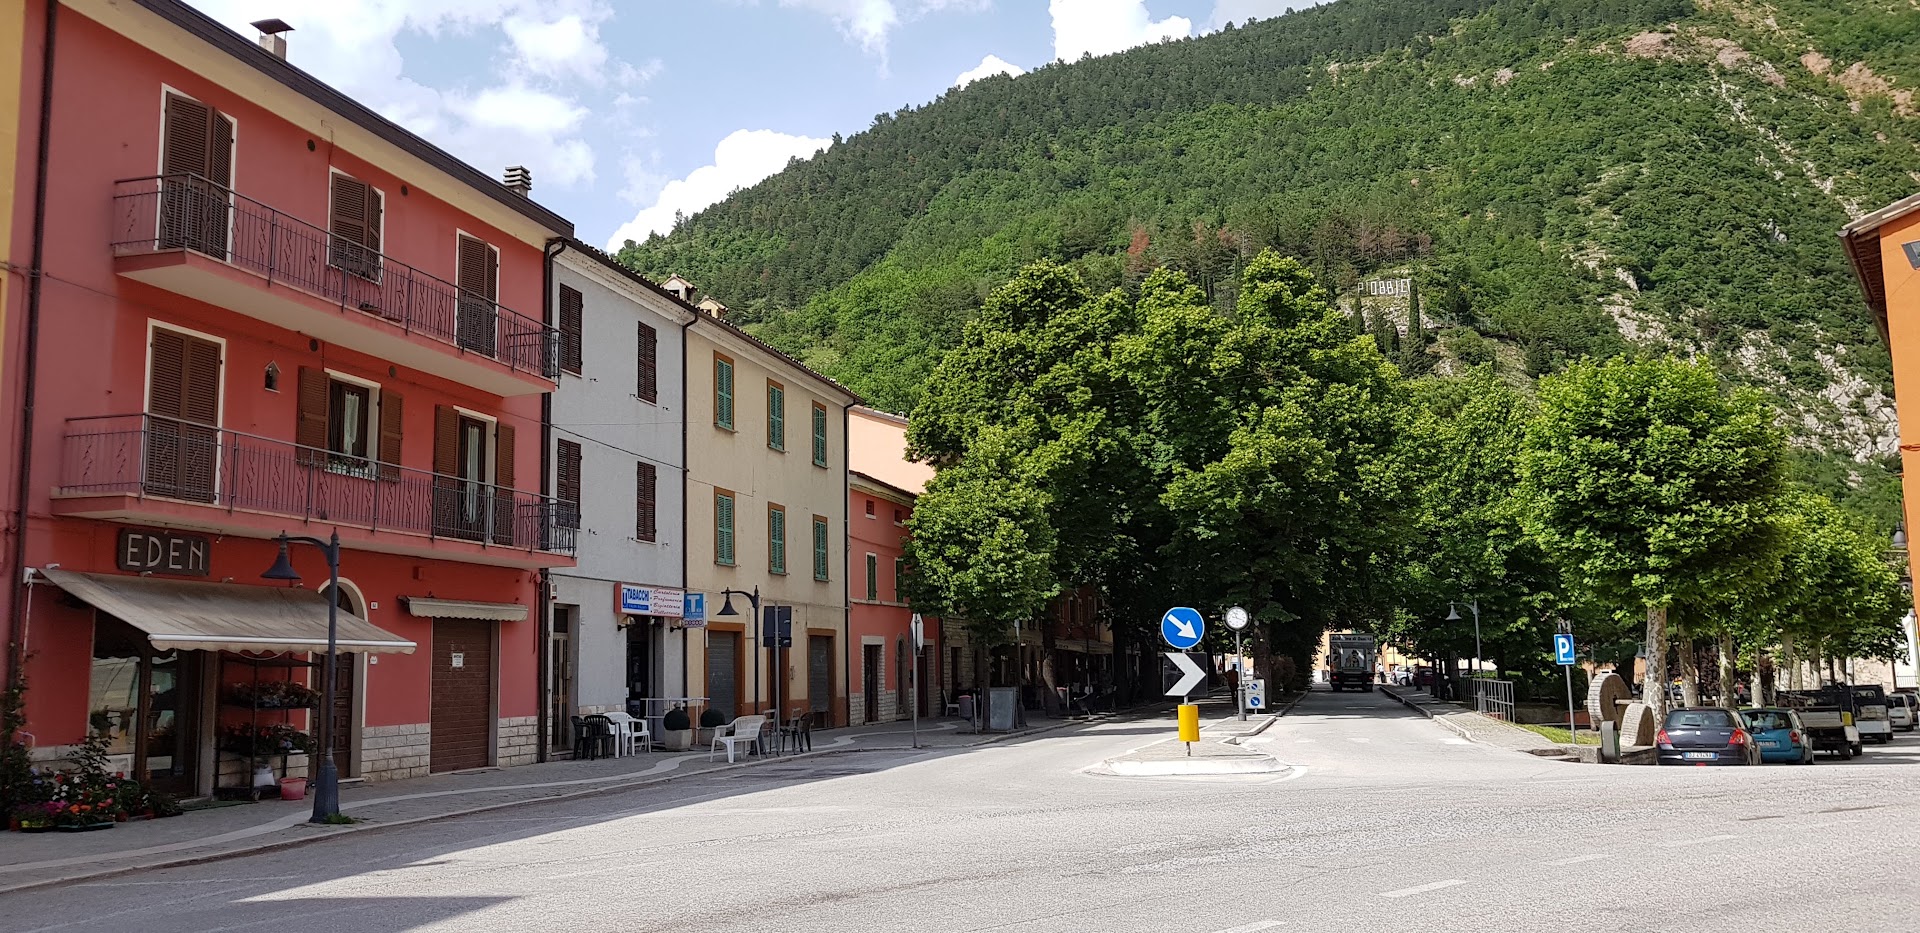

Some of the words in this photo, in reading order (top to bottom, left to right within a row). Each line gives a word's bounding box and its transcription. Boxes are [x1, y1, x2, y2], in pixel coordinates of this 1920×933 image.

[127, 534, 206, 570] EDEN
[628, 588, 649, 602] TABACCHI
[687, 595, 699, 612] T
[1558, 637, 1570, 661] P
